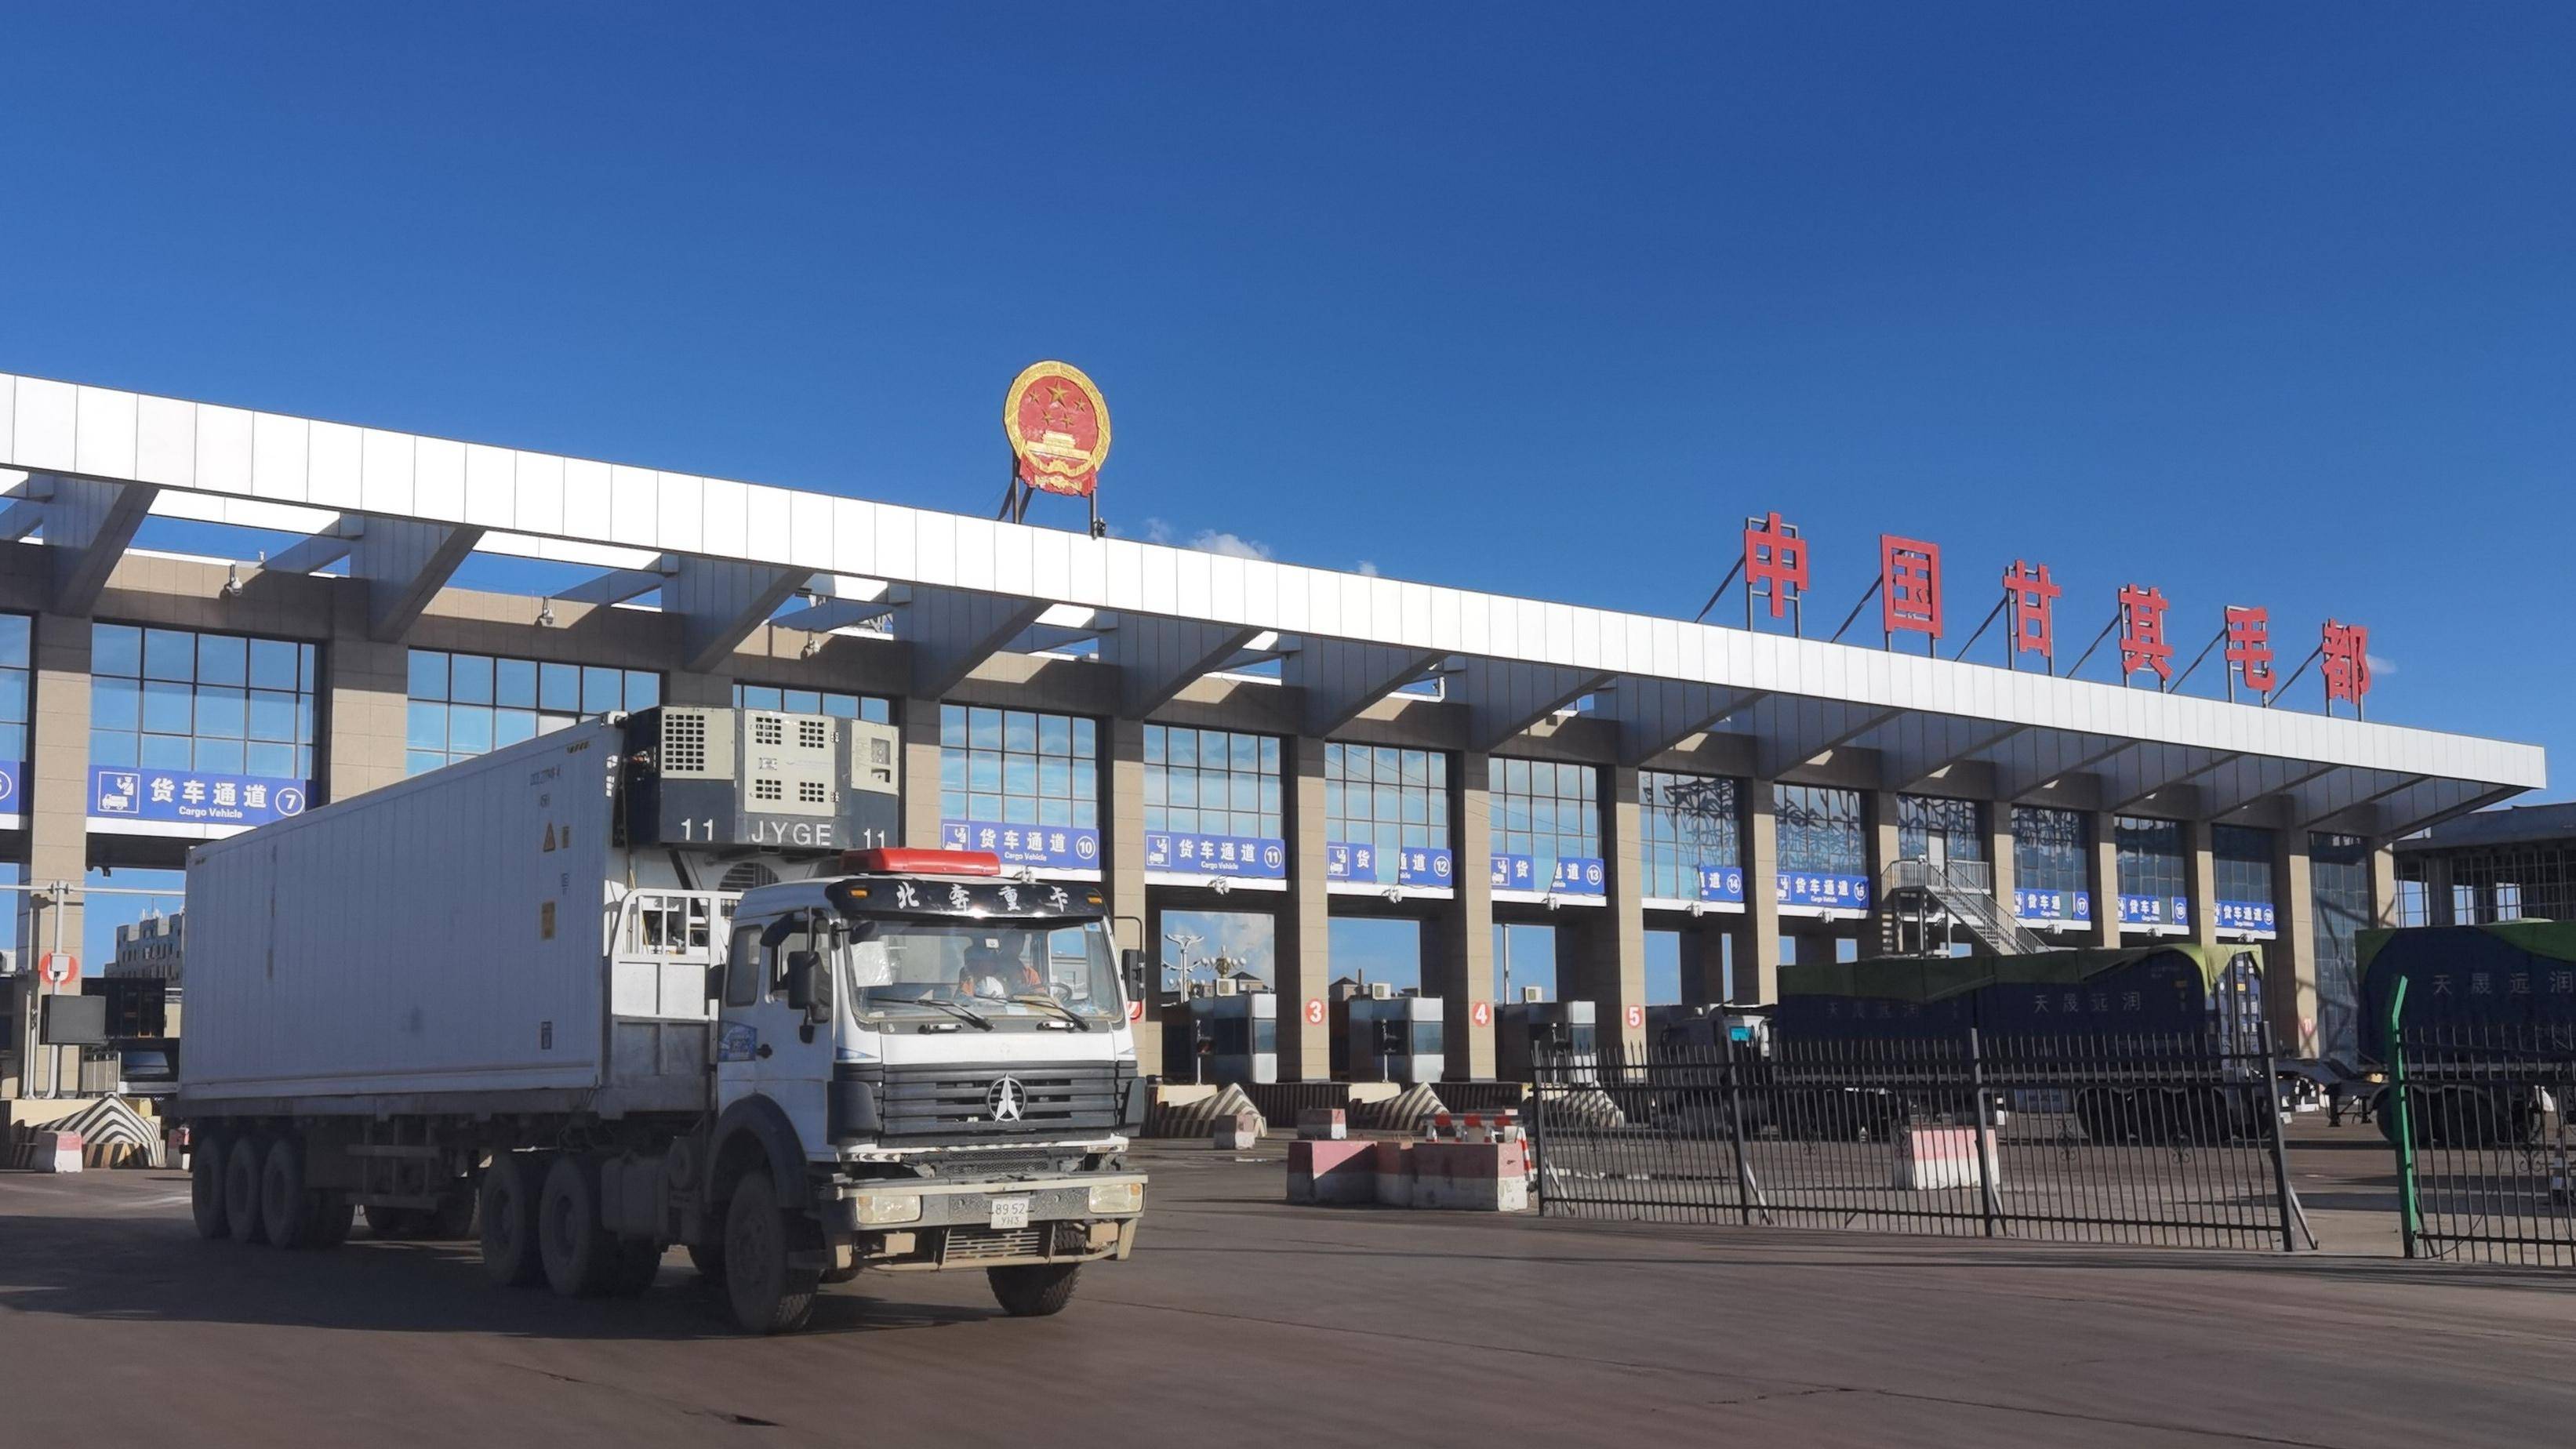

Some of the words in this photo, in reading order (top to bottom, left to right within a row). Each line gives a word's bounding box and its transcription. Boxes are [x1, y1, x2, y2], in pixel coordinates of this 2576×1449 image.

[1744, 511, 2372, 706] 中国甘其毛都
[151, 777, 267, 808] 货车通道
[179, 806, 207, 818] Cargo
[209, 808, 243, 819] Vehicle
[681, 819, 714, 841] 11
[751, 820, 832, 847] JYGE
[863, 827, 886, 849] 11
[979, 828, 1066, 853] 货车通道
[1005, 852, 1023, 861] Cargo
[1024, 852, 1048, 862] Vehicle
[1179, 839, 1255, 862] 货车通道
[1357, 850, 1370, 869] 货
[1516, 859, 1528, 878] 货
[1795, 877, 1849, 897] 货车通道
[1310, 1000, 1322, 1023] 3
[1475, 1003, 1488, 1024] 4
[1629, 1006, 1640, 1026] 5
